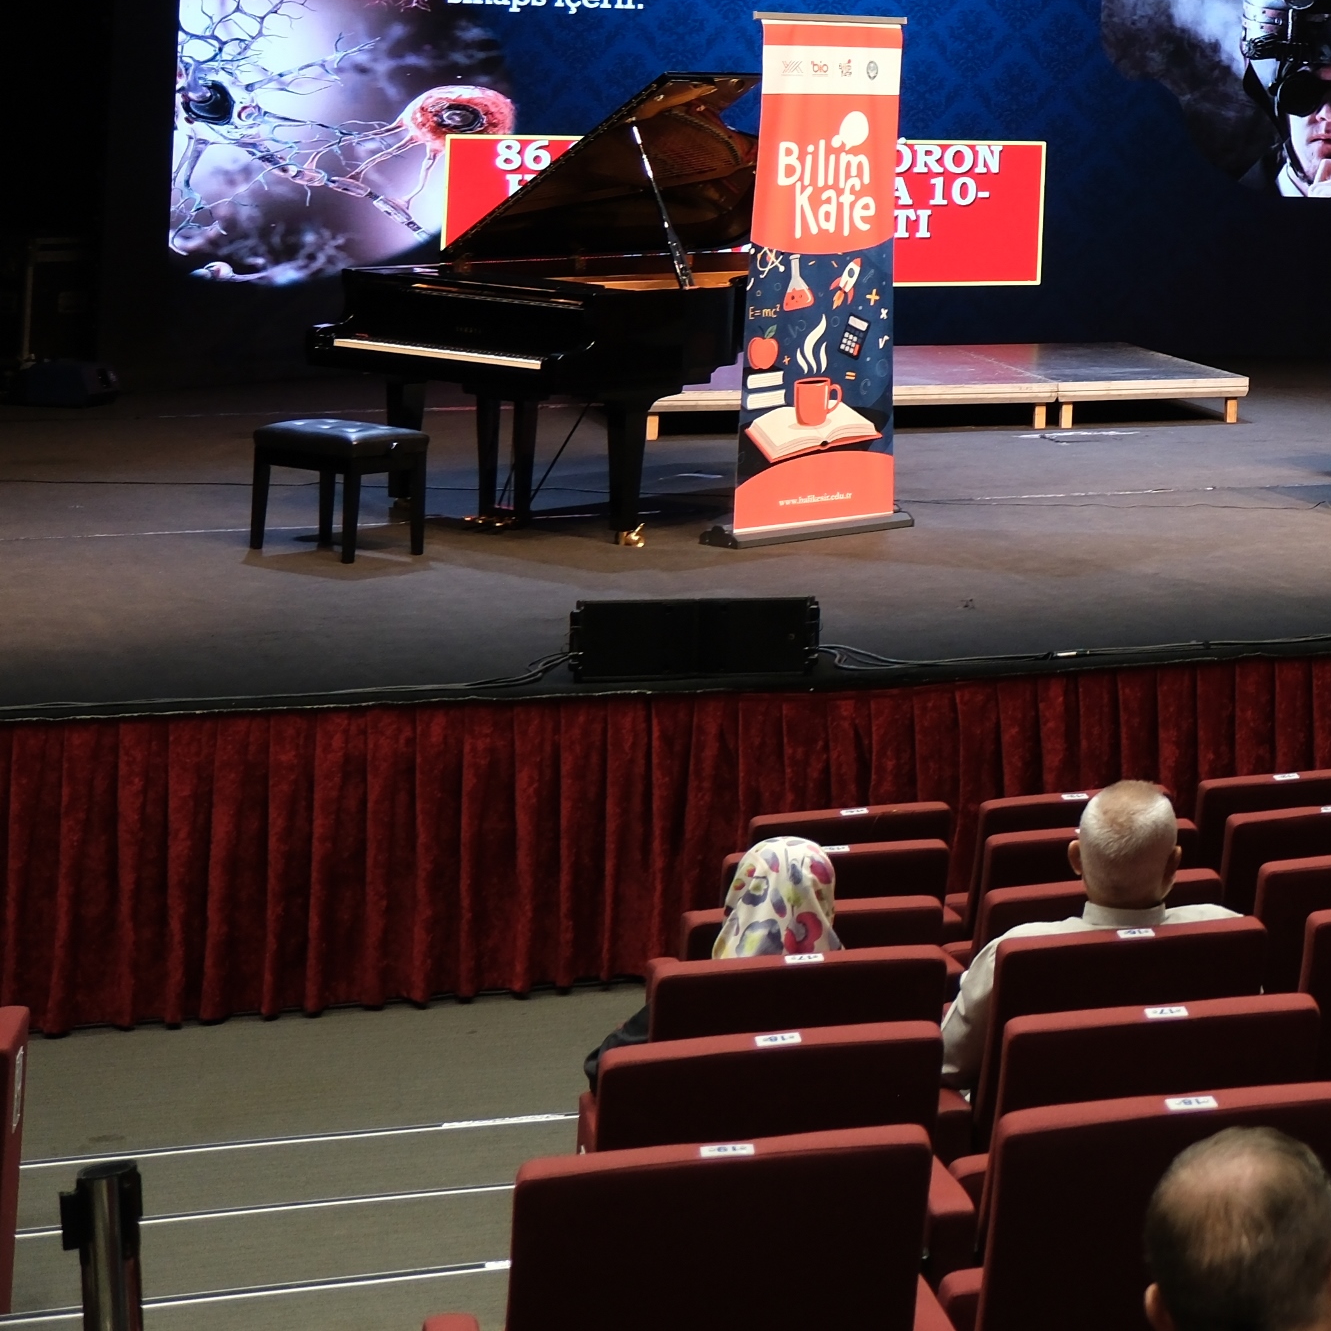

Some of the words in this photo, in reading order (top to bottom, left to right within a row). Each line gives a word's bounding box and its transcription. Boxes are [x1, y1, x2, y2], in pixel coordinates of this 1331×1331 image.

[495, 139, 551, 171] 86
[895, 137, 1003, 173] ÖRON
[777, 138, 870, 189] Bilim
[929, 176, 990, 205] 10-
[794, 176, 876, 239] Kafe
[894, 209, 932, 238] TI
[1181, 1098, 1201, 1106] 18
[716, 1145, 737, 1153] 19
